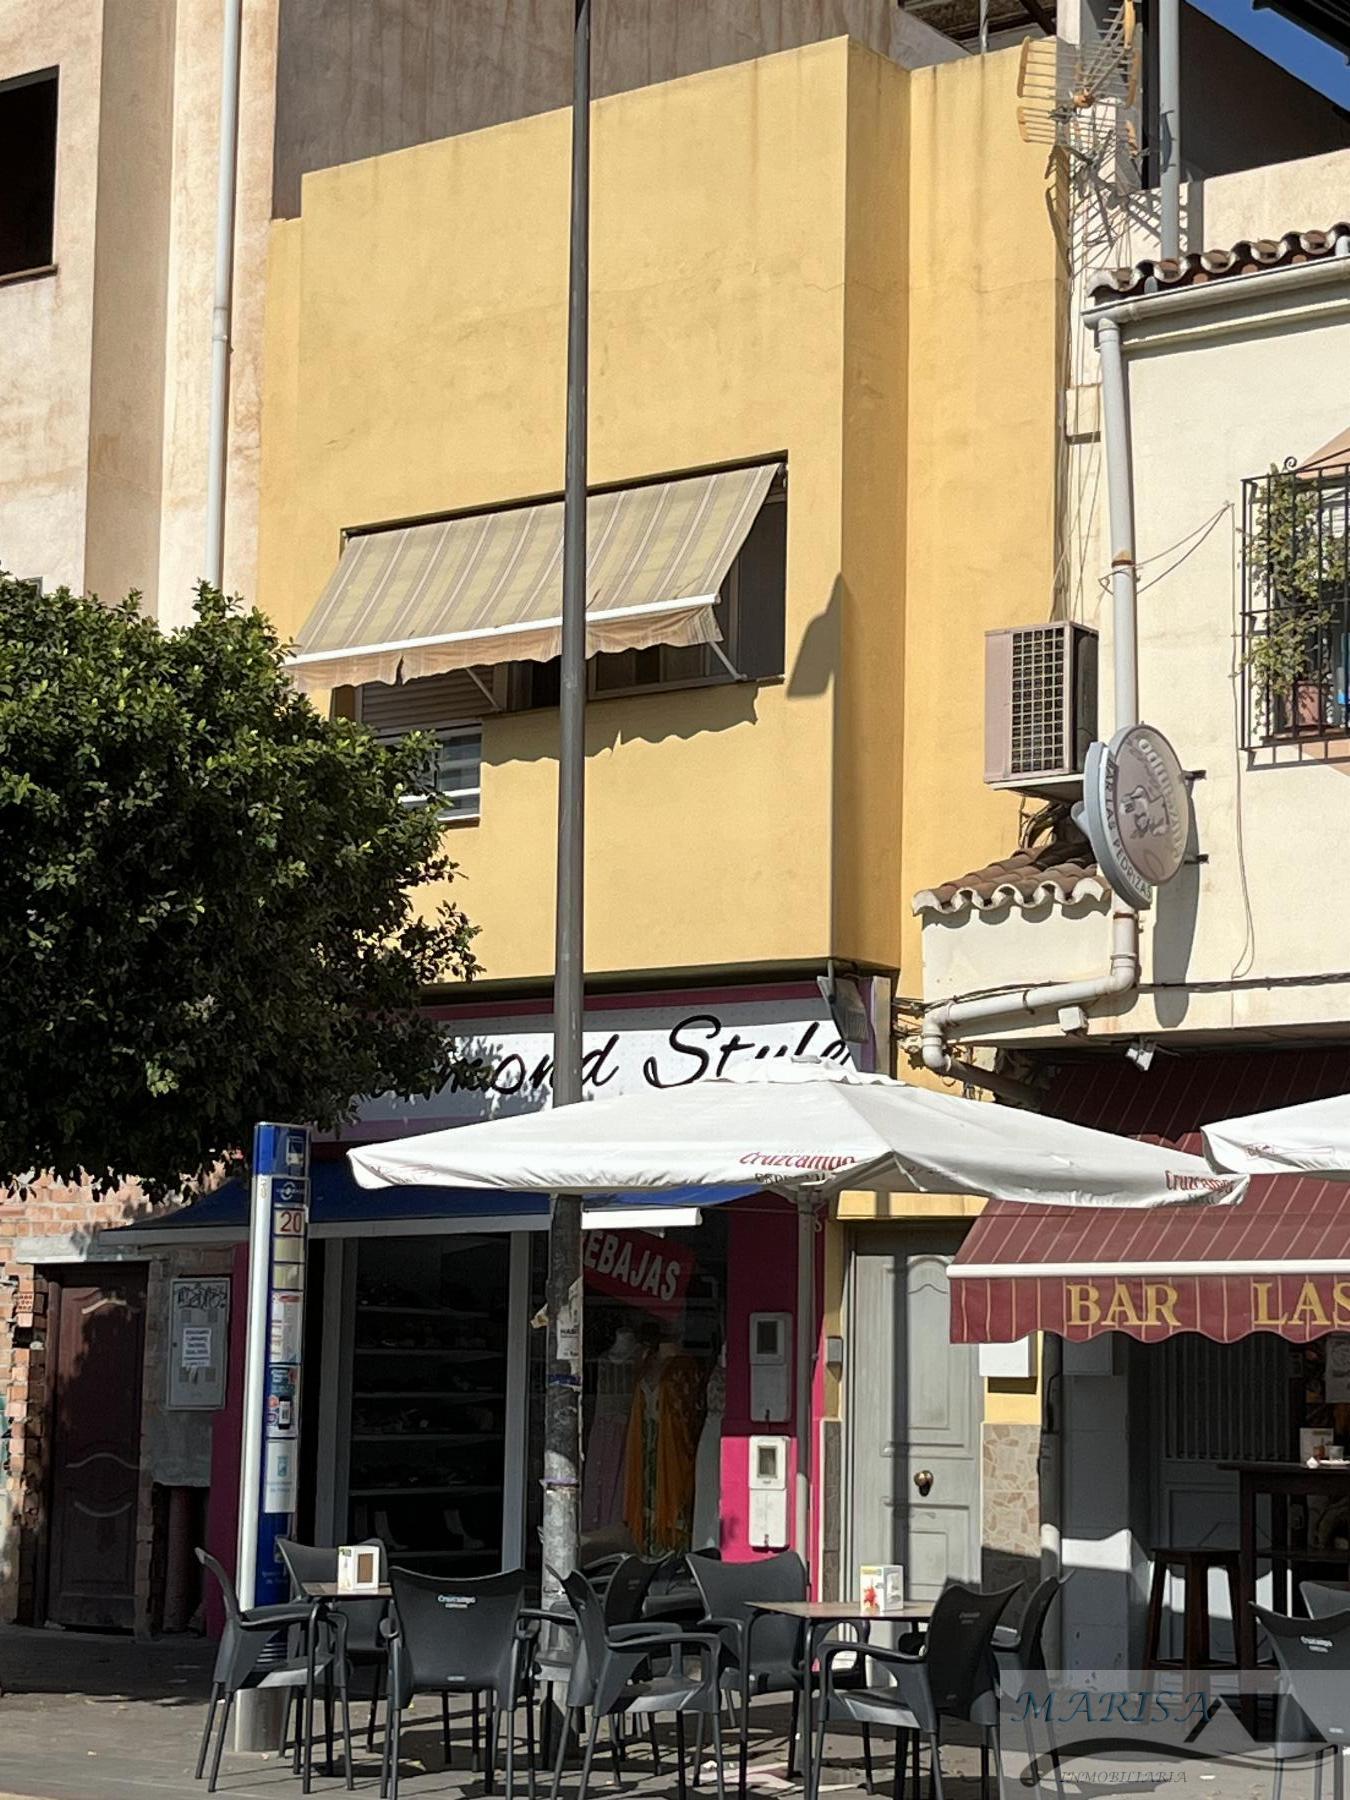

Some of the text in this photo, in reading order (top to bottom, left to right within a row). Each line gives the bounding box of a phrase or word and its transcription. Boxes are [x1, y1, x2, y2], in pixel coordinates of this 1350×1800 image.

[1105, 796, 1117, 831] LAS
[644, 1013, 854, 1088] Stle
[280, 1211, 303, 1233] 20
[582, 1230, 681, 1301] EBAJAS
[1066, 1282, 1182, 1327] BAR
